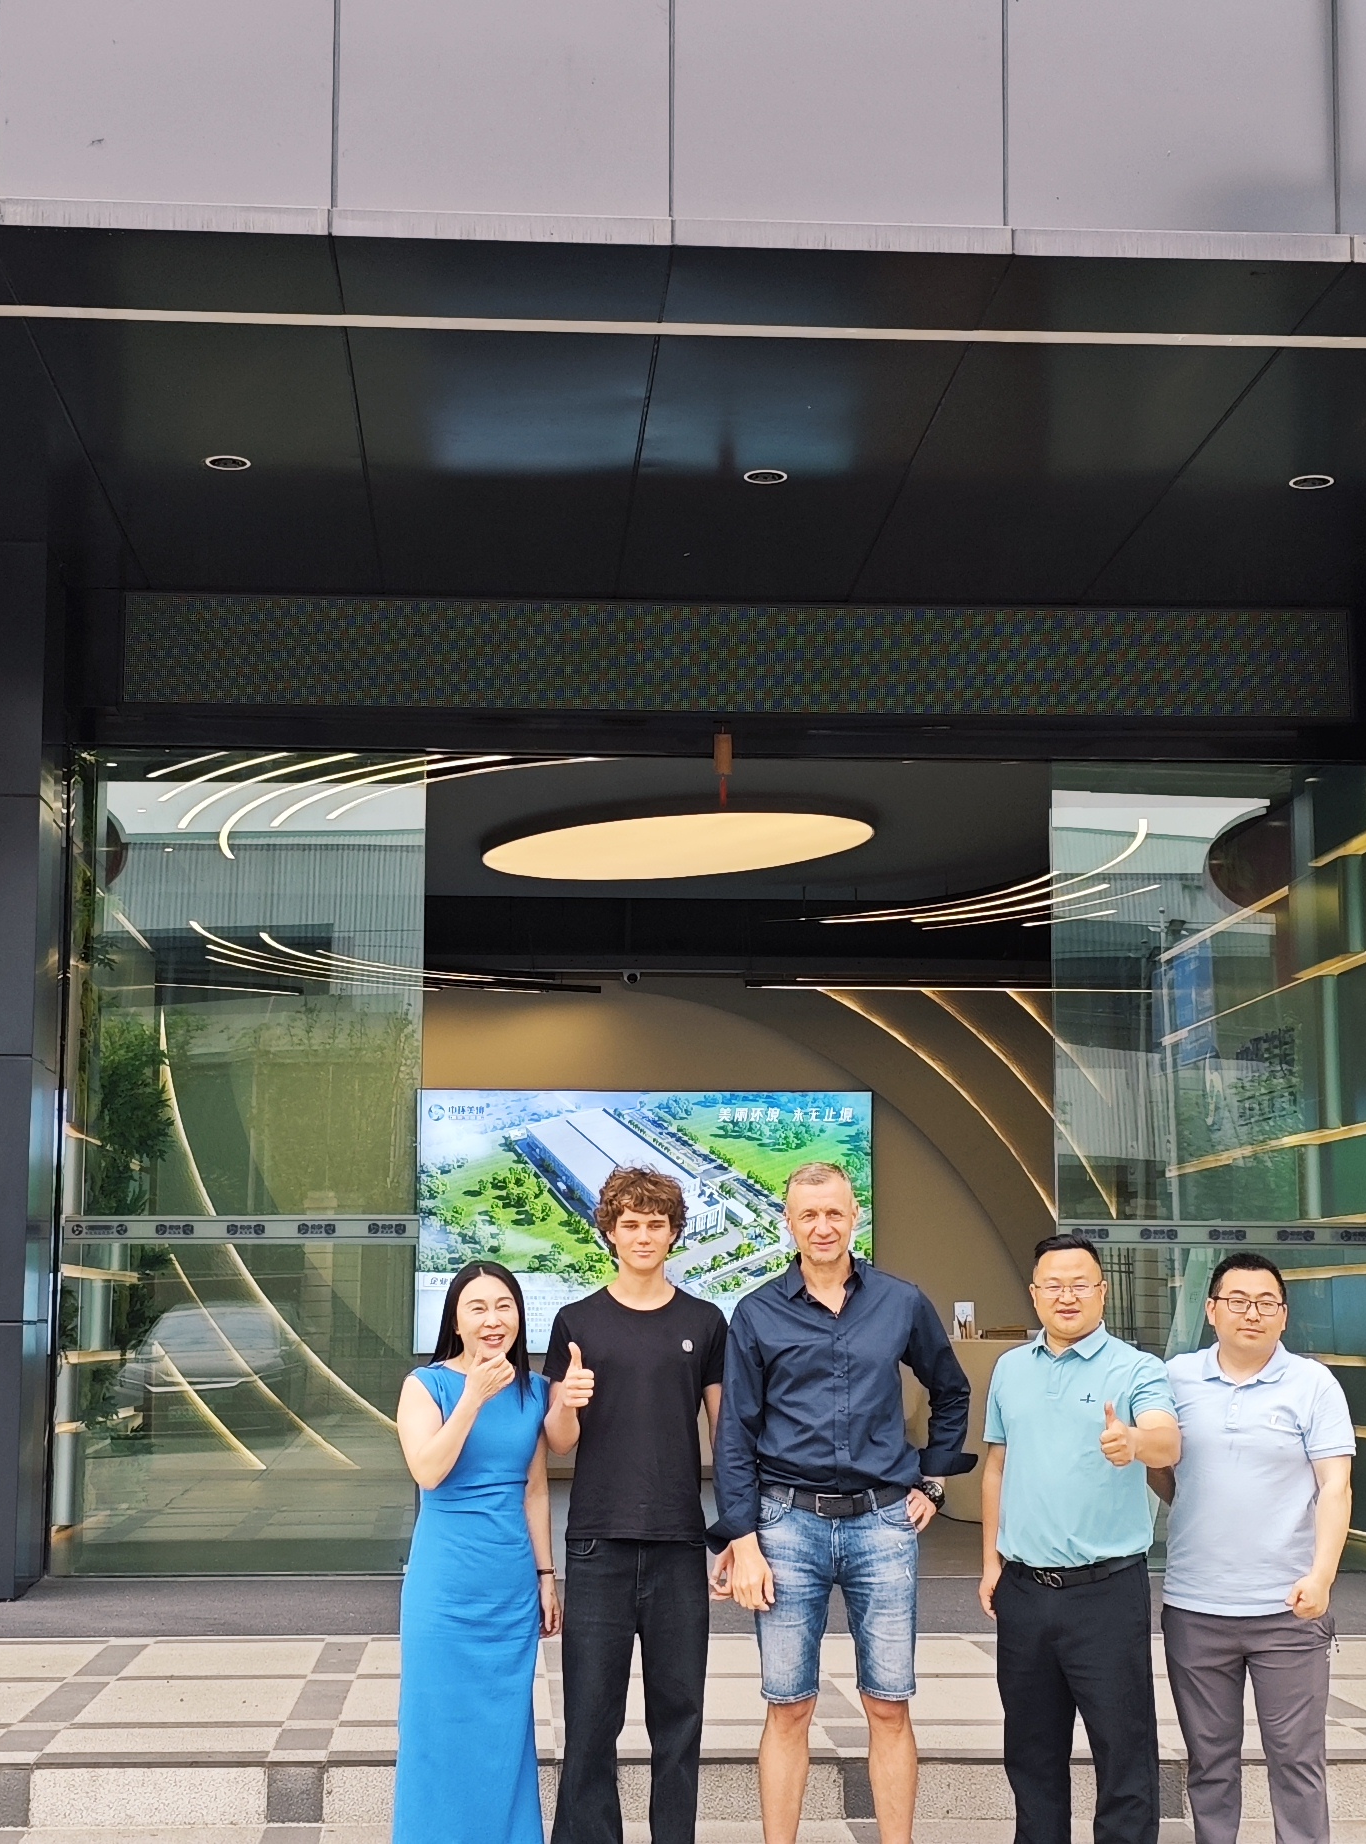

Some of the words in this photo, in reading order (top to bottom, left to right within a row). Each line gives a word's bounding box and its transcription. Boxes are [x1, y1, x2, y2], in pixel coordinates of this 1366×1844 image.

[717, 1107, 781, 1122] 美丽环境
[792, 1107, 854, 1122] 永无止境
